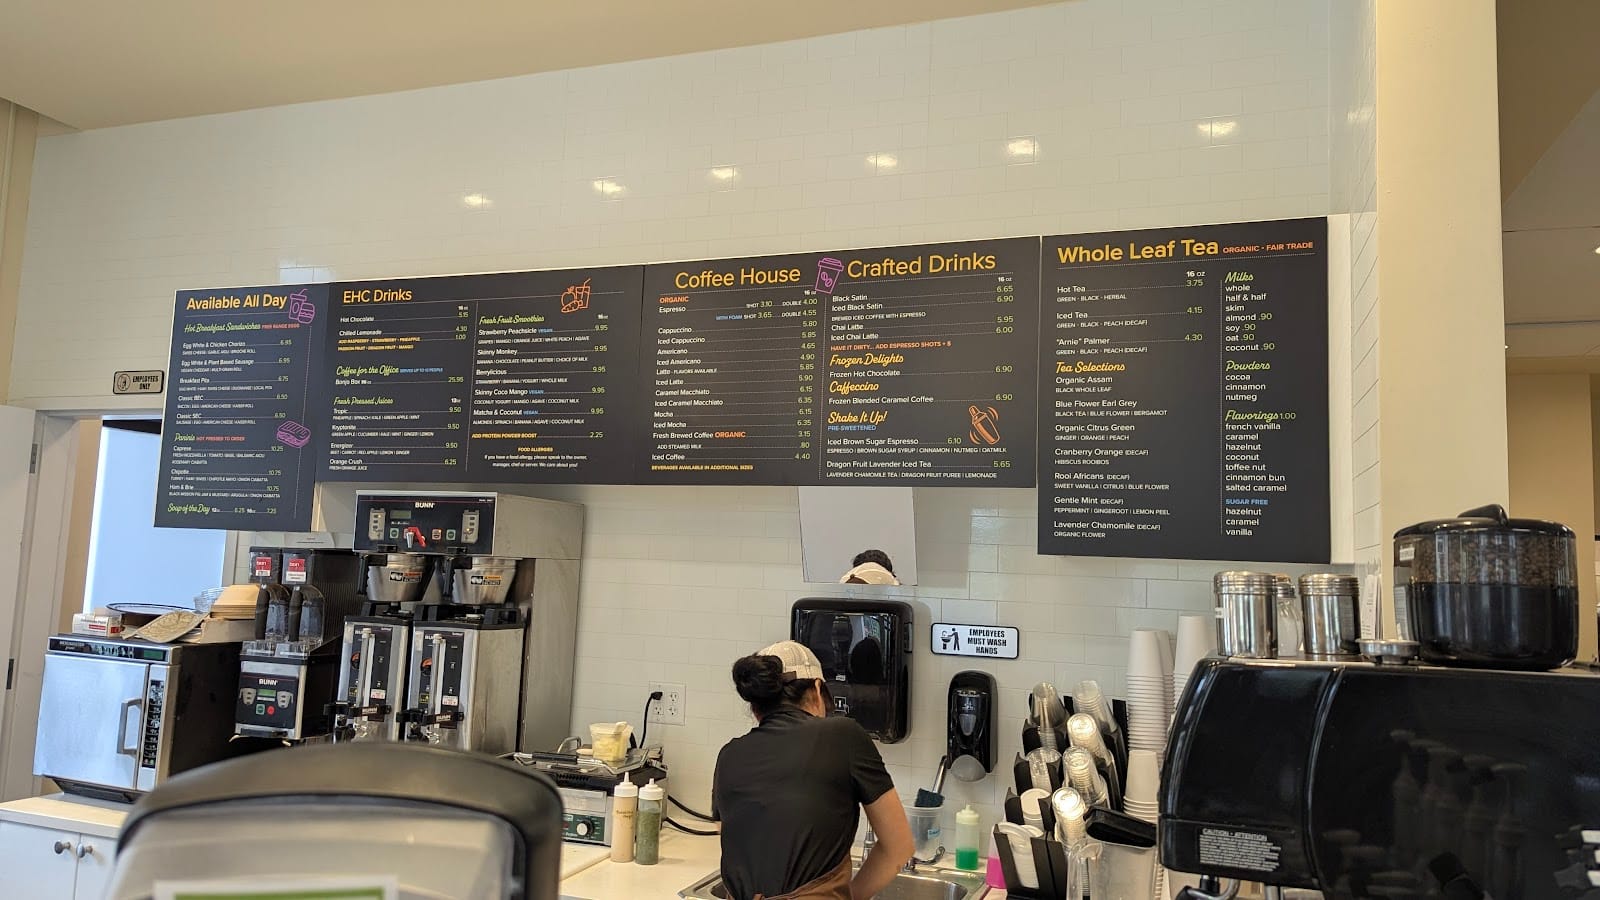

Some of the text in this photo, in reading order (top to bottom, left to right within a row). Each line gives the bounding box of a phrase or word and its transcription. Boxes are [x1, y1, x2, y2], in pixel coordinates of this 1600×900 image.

[1058, 239, 1218, 264] Whole Leaf Tea
[1223, 242, 1313, 254] ORGANIC FAIR TRADE
[847, 252, 996, 278] Crafted Drinks
[675, 268, 800, 289] Coffee House
[1225, 271, 1254, 282] Milks
[1186, 279, 1203, 287] 3.75
[343, 289, 412, 303] EHC Drinks
[187, 294, 287, 311] Available All Day
[184, 324, 196, 333] Hot
[196, 323, 224, 333] Breakfast
[226, 322, 261, 331] Sandwiches
[1185, 334, 1203, 342] 4.30
[830, 353, 904, 367] Frozen Delights
[1226, 360, 1270, 371] Powders
[336, 366, 357, 376] Coffee
[380, 365, 399, 375] Office
[1056, 361, 1125, 373] Tea Selections
[1056, 376, 1085, 385] Organic
[830, 381, 879, 394] Caffeccino
[1225, 394, 1257, 402] nutmeg
[1119, 400, 1137, 409] Grey
[828, 411, 888, 424] Shake It Up!
[1225, 410, 1278, 422] Flavorings
[1056, 424, 1085, 433] Organic
[1087, 424, 1109, 432] Citrus
[1055, 448, 1092, 457] Cranberry
[1094, 448, 1123, 457] Orange
[1092, 522, 1135, 530] Chamomile
[969, 629, 1005, 638] EMPLOYEES
[967, 637, 1007, 647] MUST WASH
[976, 647, 998, 655] HANDS
[1234, 832, 1267, 841] ATTENTION
